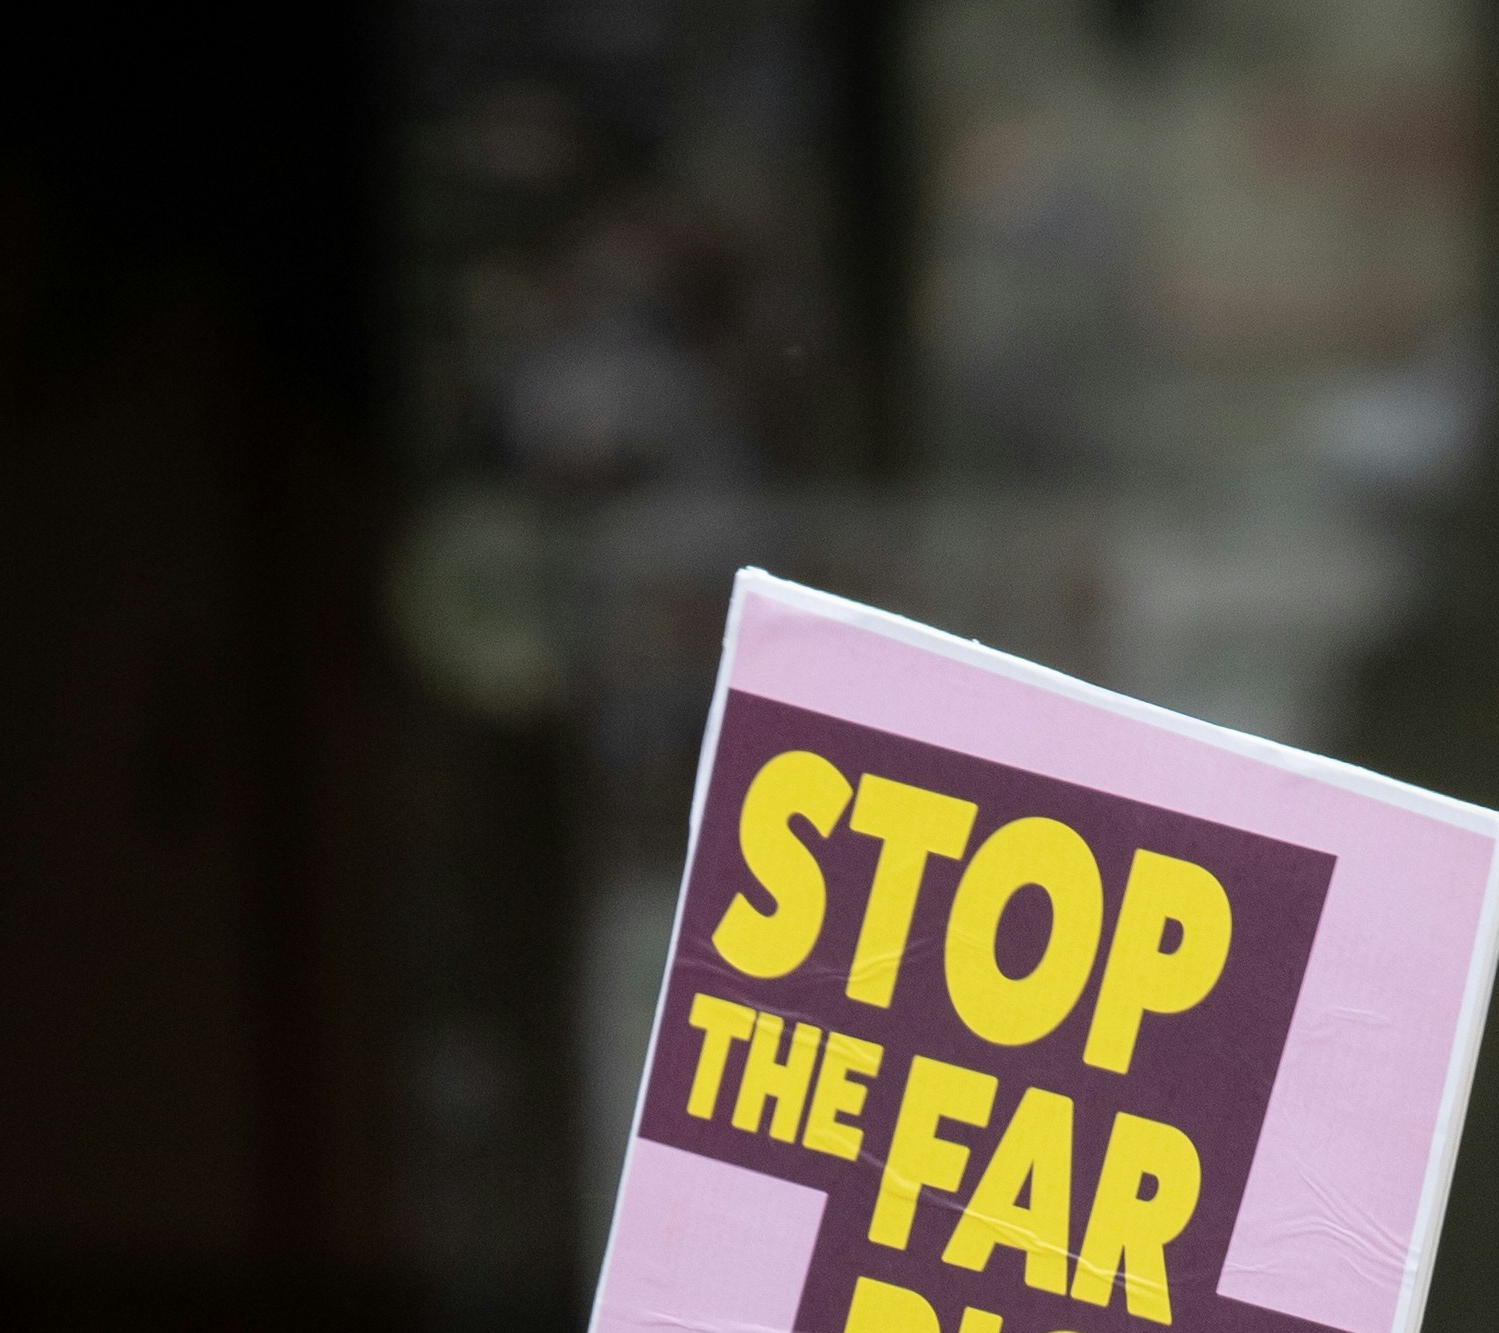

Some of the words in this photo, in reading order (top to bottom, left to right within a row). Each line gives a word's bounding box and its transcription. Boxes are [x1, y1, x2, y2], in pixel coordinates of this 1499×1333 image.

[713, 751, 1231, 1073] STOP
[688, 994, 883, 1160] THE
[868, 1056, 1201, 1324] FAR
